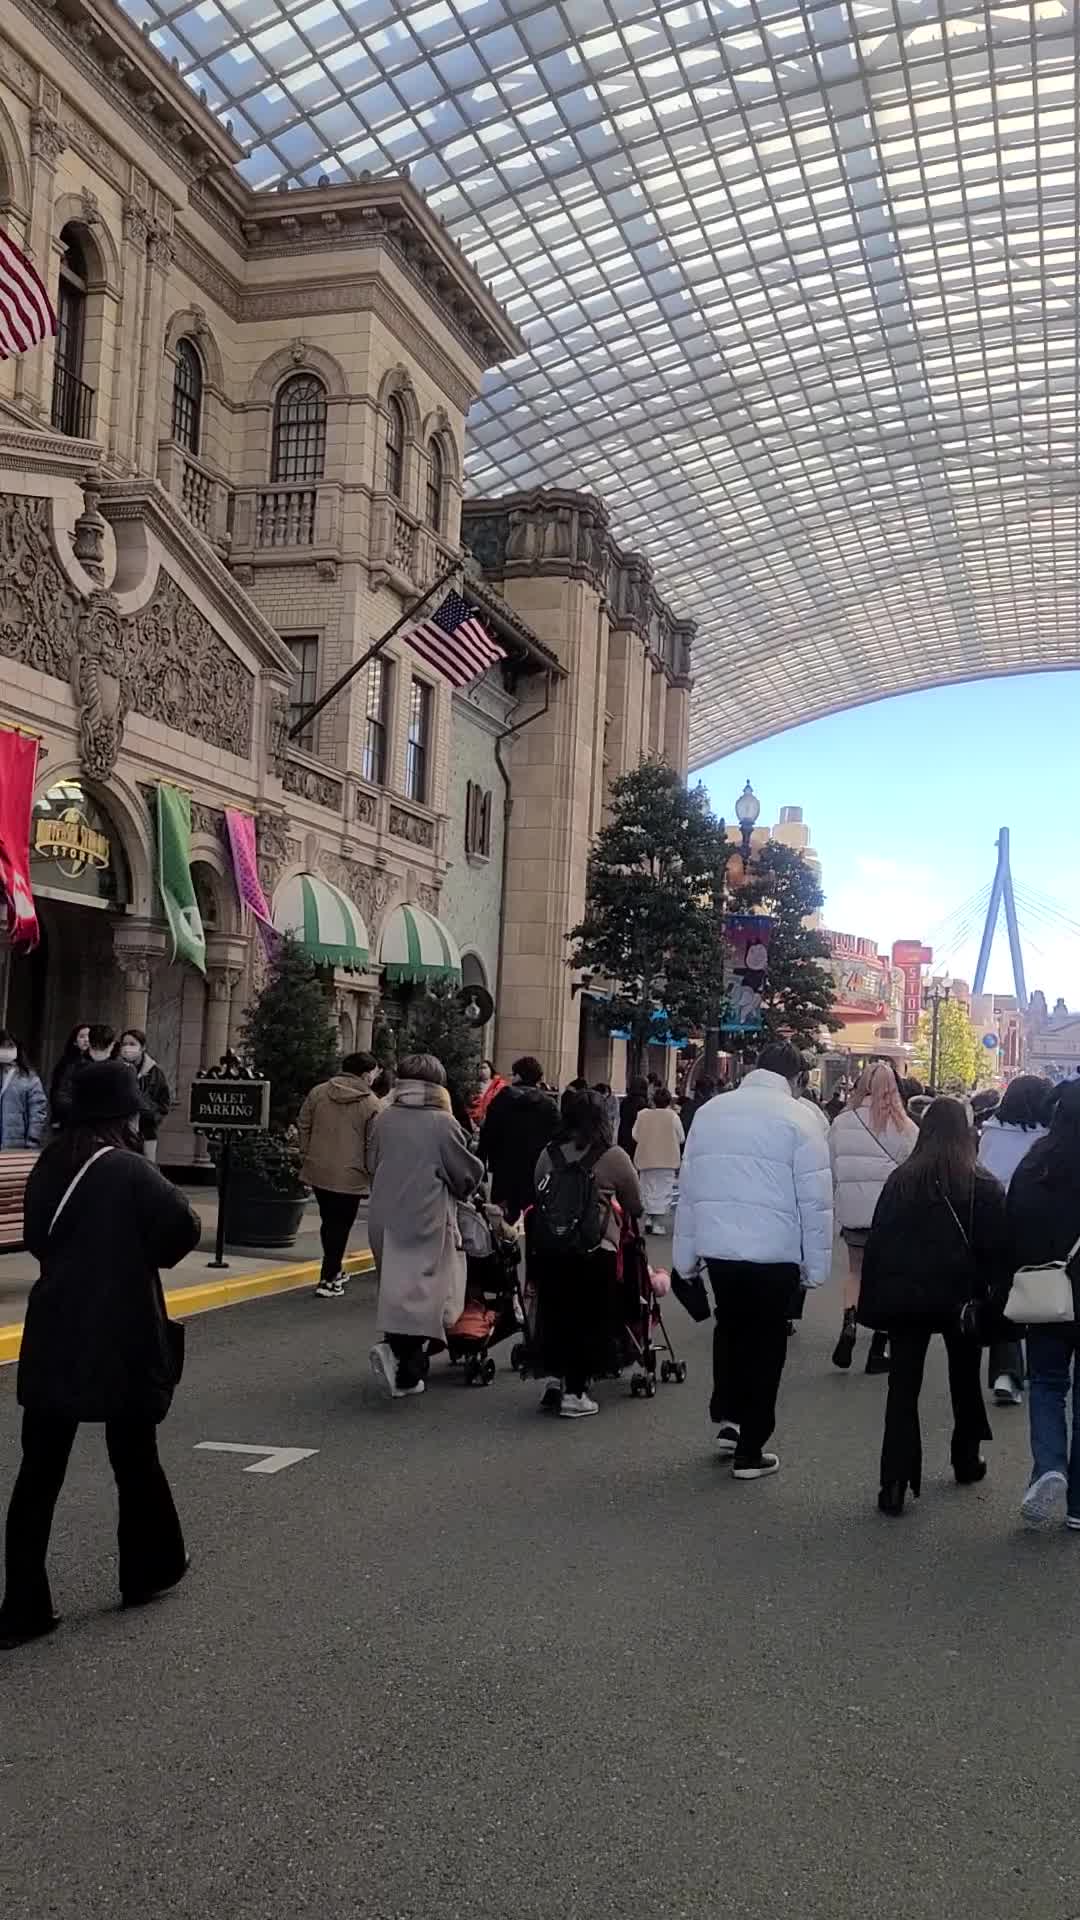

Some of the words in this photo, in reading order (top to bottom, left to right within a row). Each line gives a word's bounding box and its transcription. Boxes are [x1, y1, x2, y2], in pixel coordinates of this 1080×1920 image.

[52, 845, 94, 864] STORE
[208, 1091, 247, 1104] VALET
[199, 1103, 253, 1117] PARKING
